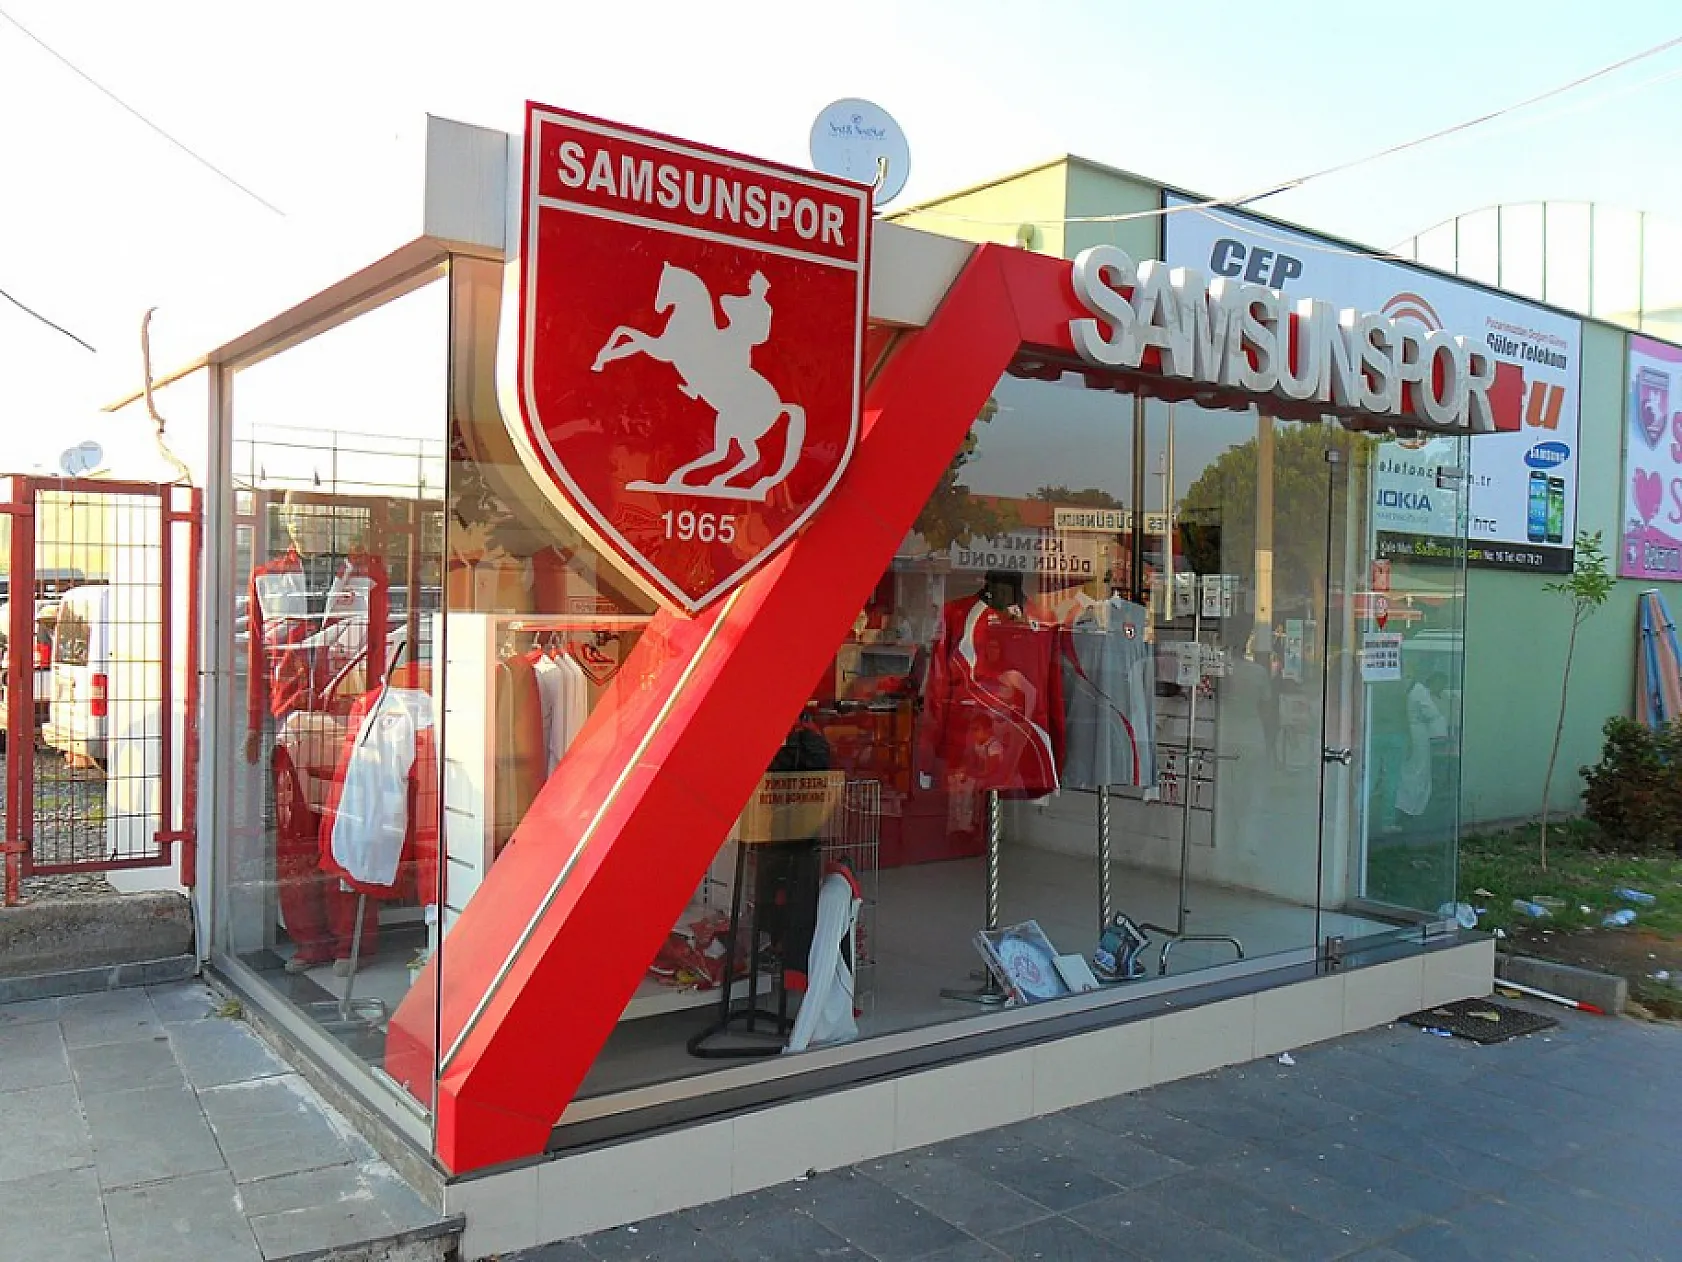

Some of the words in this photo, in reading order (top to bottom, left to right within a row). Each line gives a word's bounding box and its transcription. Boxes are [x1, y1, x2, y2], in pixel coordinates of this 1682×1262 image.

[557, 140, 845, 247] SAMSUNSPOR
[1210, 238, 1303, 290] CEP
[1070, 244, 1497, 433] SAMSUNSPOR
[661, 510, 736, 543] 1965
